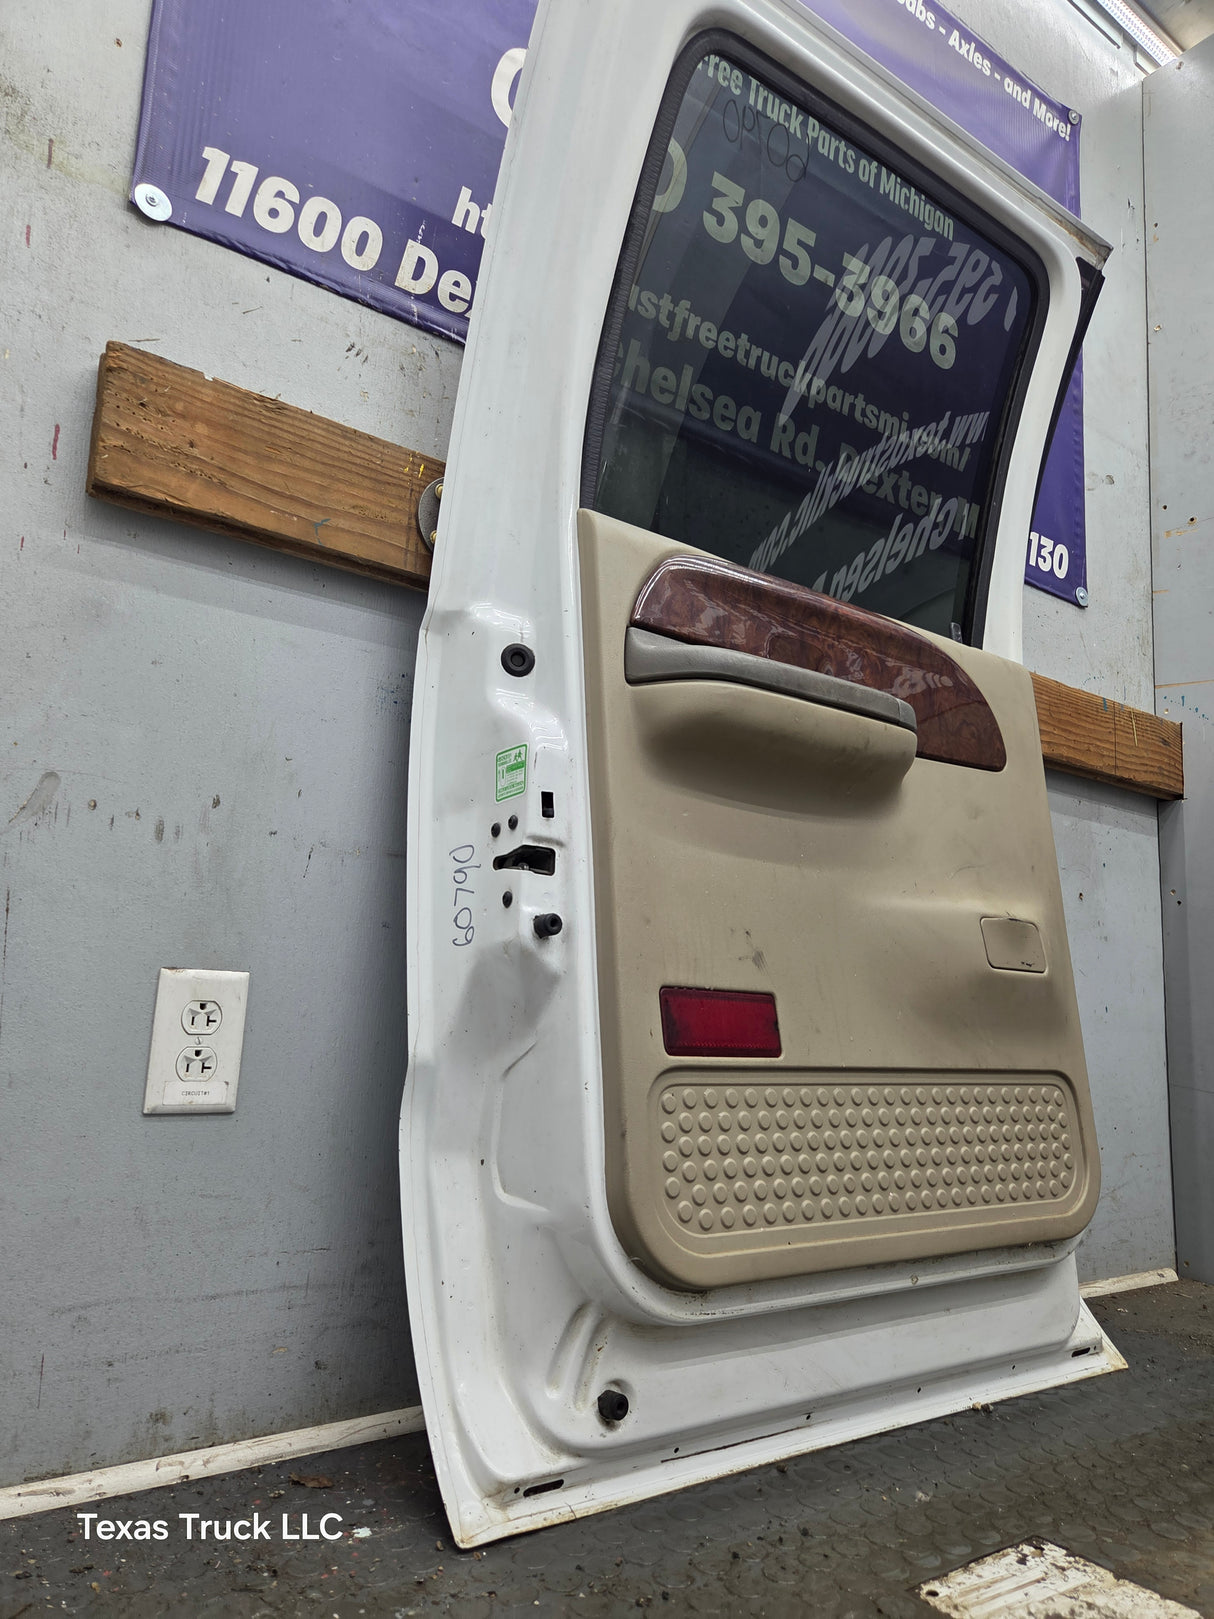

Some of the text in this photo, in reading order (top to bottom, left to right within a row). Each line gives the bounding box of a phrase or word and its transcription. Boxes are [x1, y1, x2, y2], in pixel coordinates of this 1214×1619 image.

[749, 75, 804, 140] Truck
[806, 115, 855, 174] Parts
[858, 159, 878, 188] of
[880, 166, 954, 241] Michigan
[897, 0, 936, 29] abs
[948, 29, 991, 76] Axles
[1004, 77, 1032, 109] and
[1033, 97, 1071, 142] More!
[703, 171, 958, 369] 395-3966
[195, 146, 383, 271] 11600
[395, 239, 472, 319] De
[770, 412, 826, 472] Rd.
[1029, 531, 1069, 579] 130
